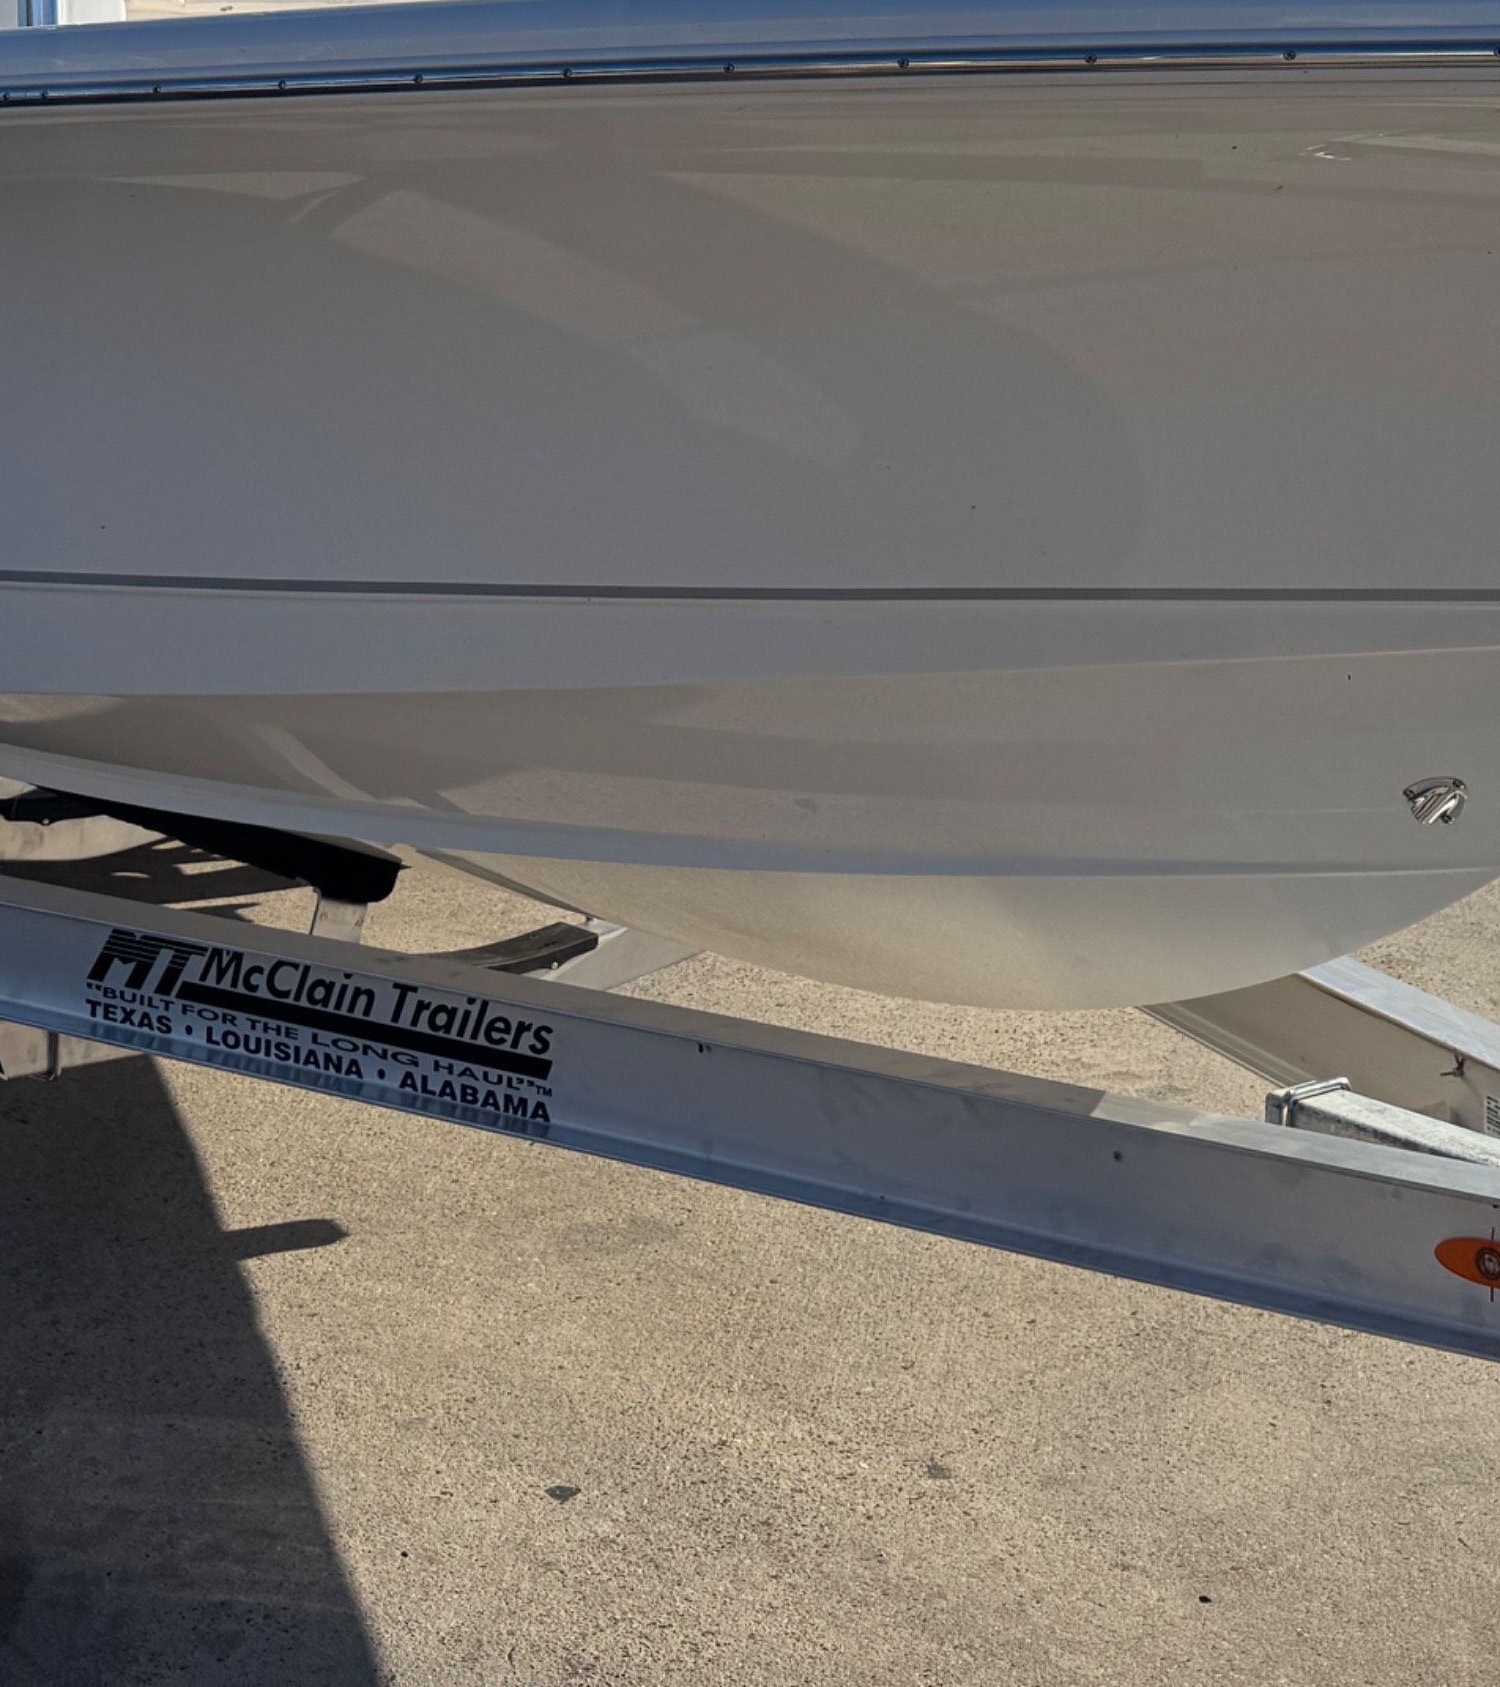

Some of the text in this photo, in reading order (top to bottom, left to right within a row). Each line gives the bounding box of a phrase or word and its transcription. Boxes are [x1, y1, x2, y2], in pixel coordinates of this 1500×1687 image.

[86, 927, 554, 1056] MT McClain Trailers
[180, 1003, 239, 1028] FOR
[245, 1016, 300, 1041] THE
[311, 1032, 421, 1069] LONG
[84, 998, 551, 1124] TEXAS LOUISIANA ALABAMA
